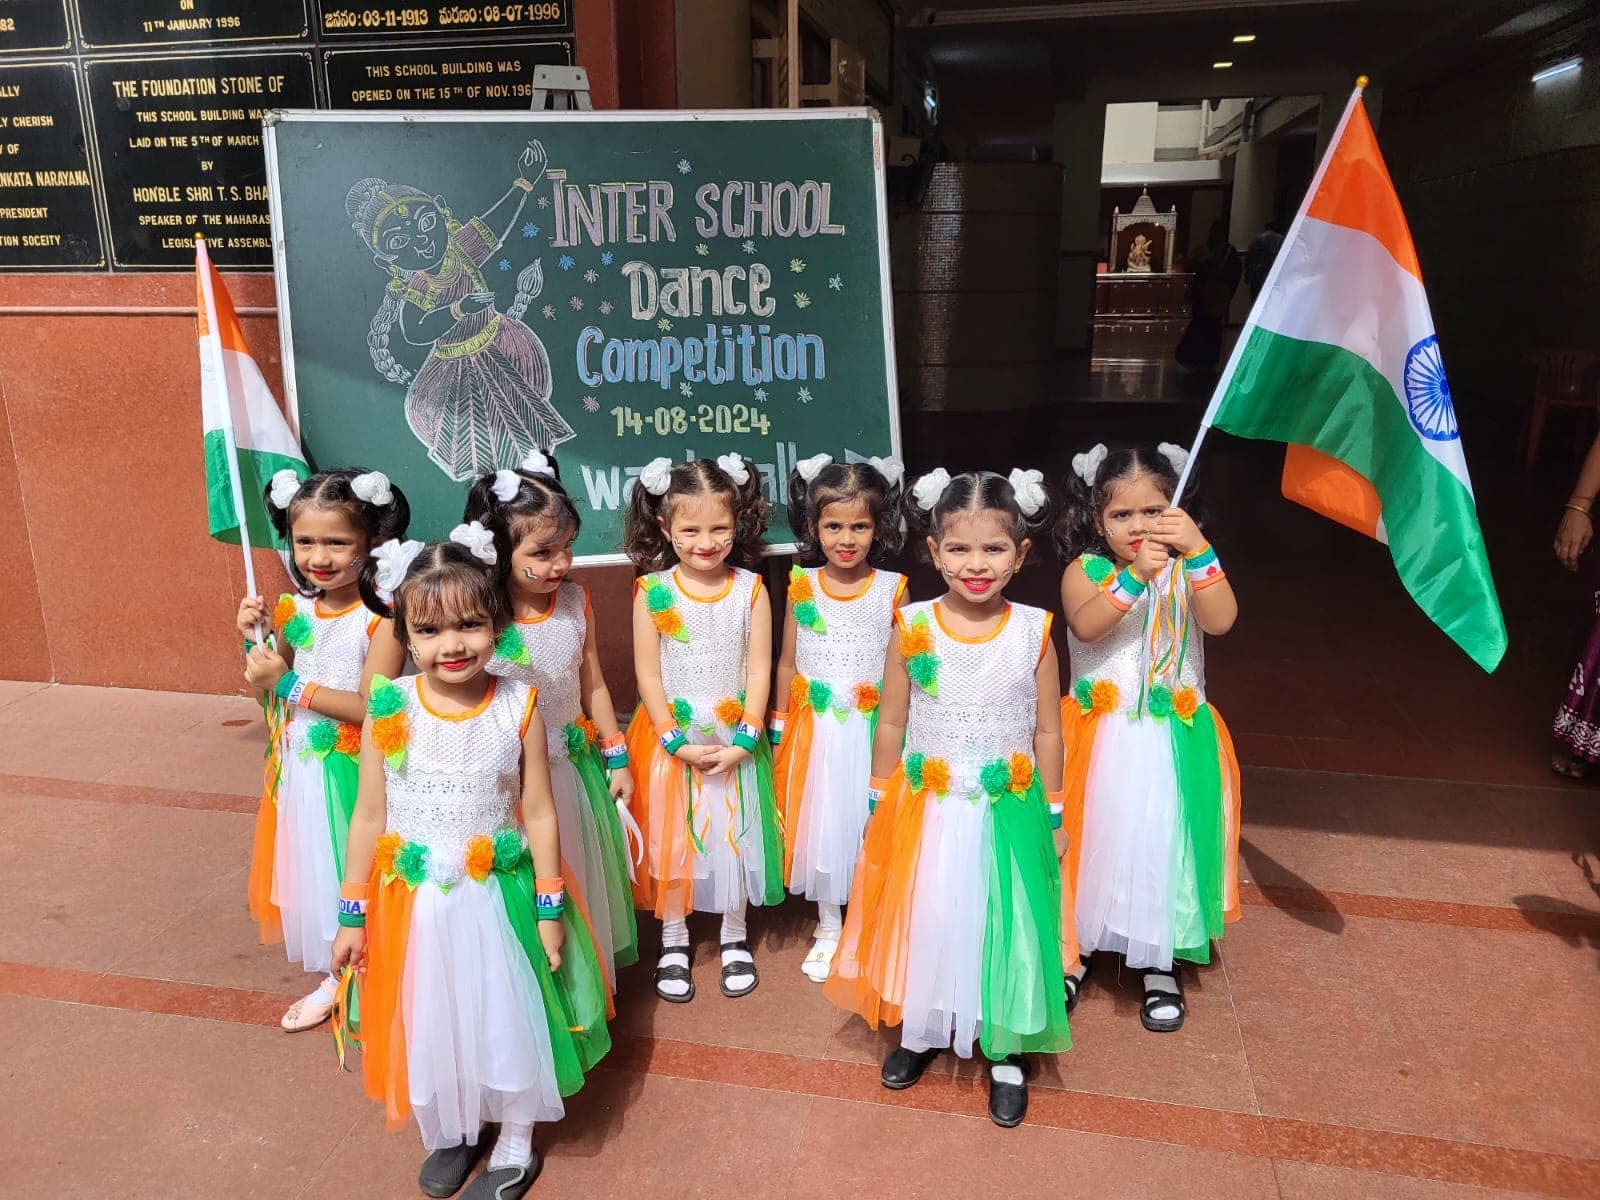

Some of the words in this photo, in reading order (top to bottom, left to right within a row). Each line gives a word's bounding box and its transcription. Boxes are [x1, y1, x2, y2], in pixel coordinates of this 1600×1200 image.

[0, 18, 16, 31] 82
[167, 17, 213, 31] JANUARY
[215, 16, 241, 28] 1996
[365, 65, 391, 78] THIS
[394, 63, 437, 77] SCHOOL
[441, 61, 493, 75] BUILDING
[497, 60, 522, 73] WAS
[112, 80, 139, 98] THE
[141, 77, 217, 97] FOUNDATION
[221, 76, 263, 95] STONE
[268, 75, 285, 93] OF
[351, 89, 393, 102] OPENED
[396, 88, 411, 100] ON
[413, 87, 436, 100] THE
[466, 85, 481, 98] OF
[12, 115, 54, 127] CHERISH
[136, 110, 158, 123] THIS
[160, 109, 197, 122] SCHOOL
[200, 108, 245, 121] BUILDING
[129, 136, 152, 148] LAID
[154, 136, 167, 148] ON
[169, 136, 189, 147] THE
[211, 135, 223, 147] OF
[226, 134, 260, 146] MARCH
[7, 143, 20, 155] OF
[200, 160, 214, 172] BY
[36, 170, 91, 187] NARAYANA
[186, 186, 213, 202] SHRI
[0, 207, 48, 218] PRESIDENT
[546, 168, 677, 248] INTER
[694, 179, 846, 240] SCHOOL
[138, 214, 183, 226] SPEAKER
[185, 214, 198, 225] OF
[202, 214, 222, 225] THE
[22, 234, 61, 247] SOCEITY
[162, 237, 224, 249] LEGISLIVE
[227, 237, 272, 249] ASSEMBL
[621, 260, 777, 321] Dance
[575, 322, 826, 389] Competition
[609, 403, 772, 437] 14-08-2024
